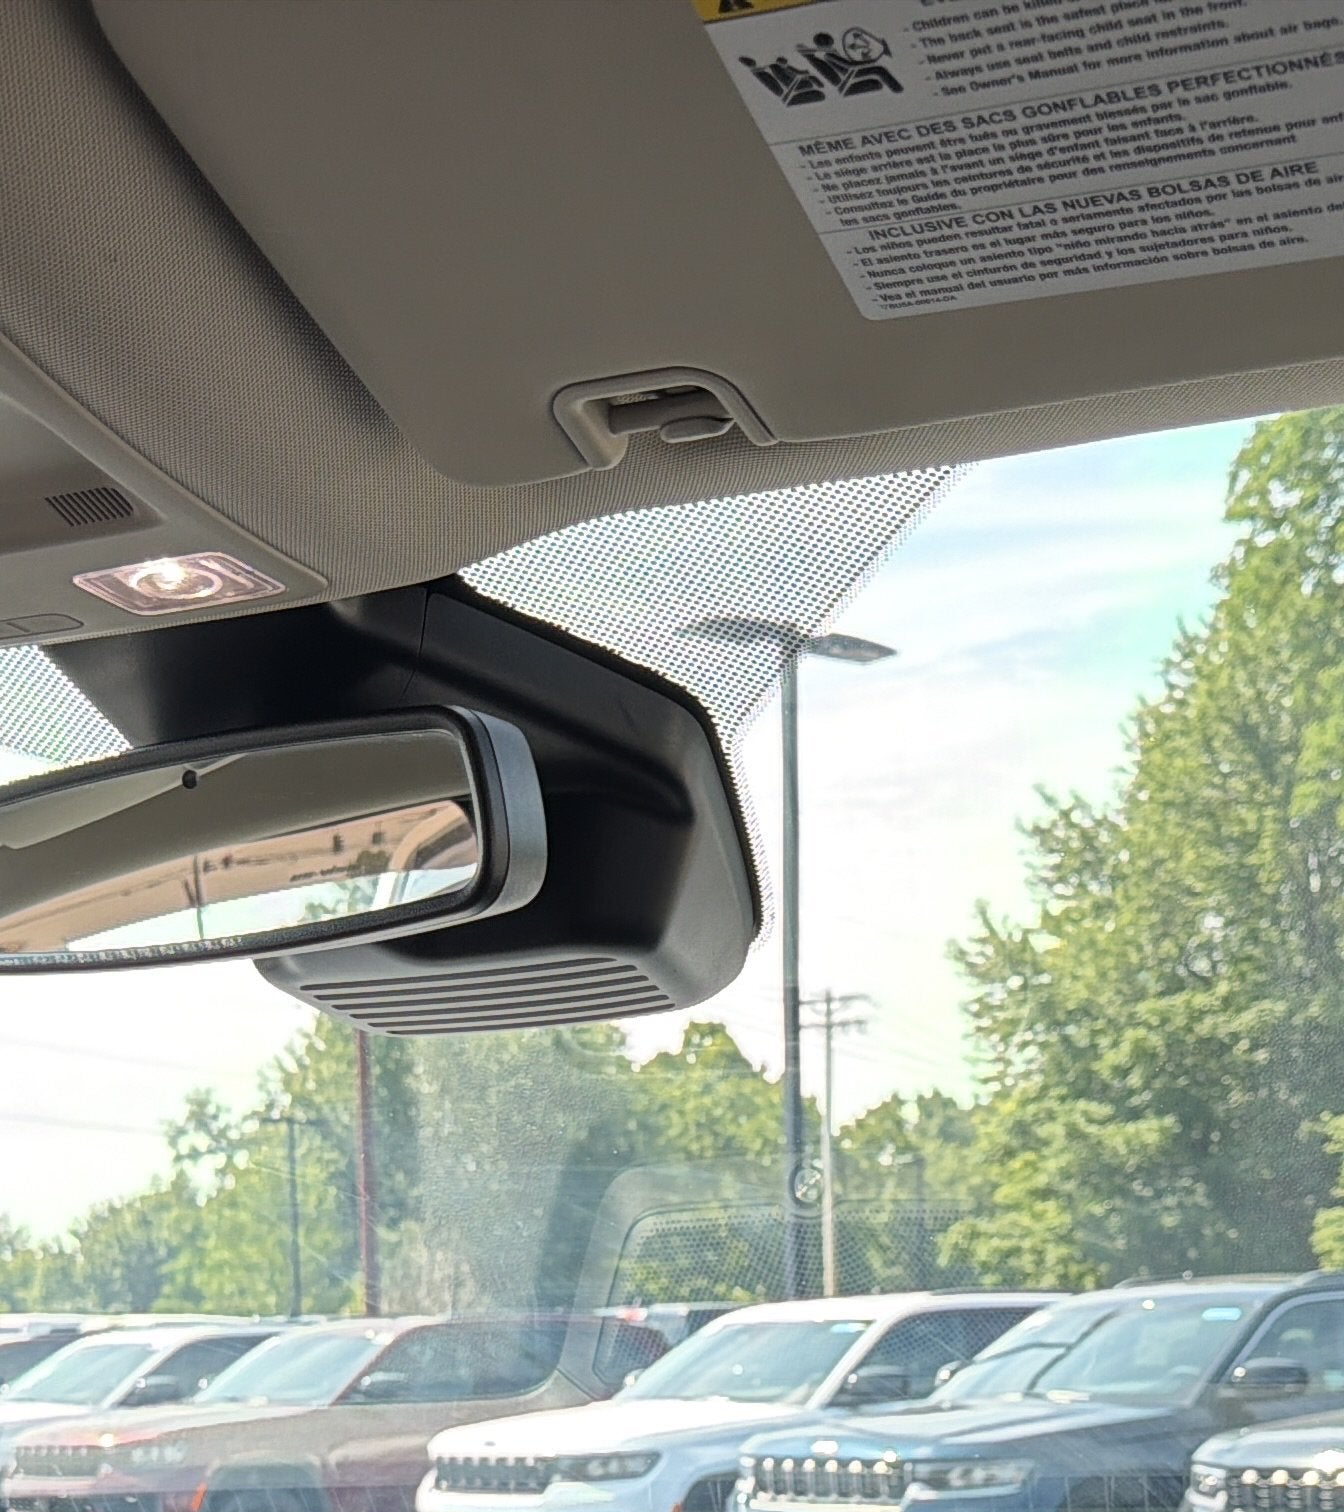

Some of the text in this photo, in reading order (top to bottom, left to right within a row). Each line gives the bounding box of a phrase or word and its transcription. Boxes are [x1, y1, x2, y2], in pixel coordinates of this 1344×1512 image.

[910, 10, 970, 32] Children
[972, 7, 999, 21] can
[917, 33, 947, 49] The
[946, 26, 983, 43] back
[983, 19, 1017, 36] seat
[1017, 16, 1034, 30] is
[1033, 11, 1060, 27] the
[1059, 2, 1107, 22] safest
[924, 47, 967, 65] Never
[966, 42, 995, 59] put
[994, 42, 1006, 52] a
[1006, 24, 1087, 52] rear-facing
[1086, 17, 1124, 35] child
[1124, 11, 1159, 28] seat
[1159, 7, 1177, 21] in
[1177, 2, 1204, 18] the
[931, 16, 1229, 82] Always use seat belts and child restraints.
[939, 13, 1344, 96] See Owner's Manual for more information about air bags.
[795, 134, 856, 156] MÊME
[855, 126, 913, 146] AVEC
[913, 118, 958, 136] DES
[958, 108, 1018, 129] SACS
[1018, 82, 1163, 119] GONFLABLES
[866, 161, 1319, 240] INCLUSIVE CON LAS NUEVAS BOLSAS DE AIRE
[878, 234, 1308, 301] Vea el manual del usuario por más información sobre bolsas de aire.
